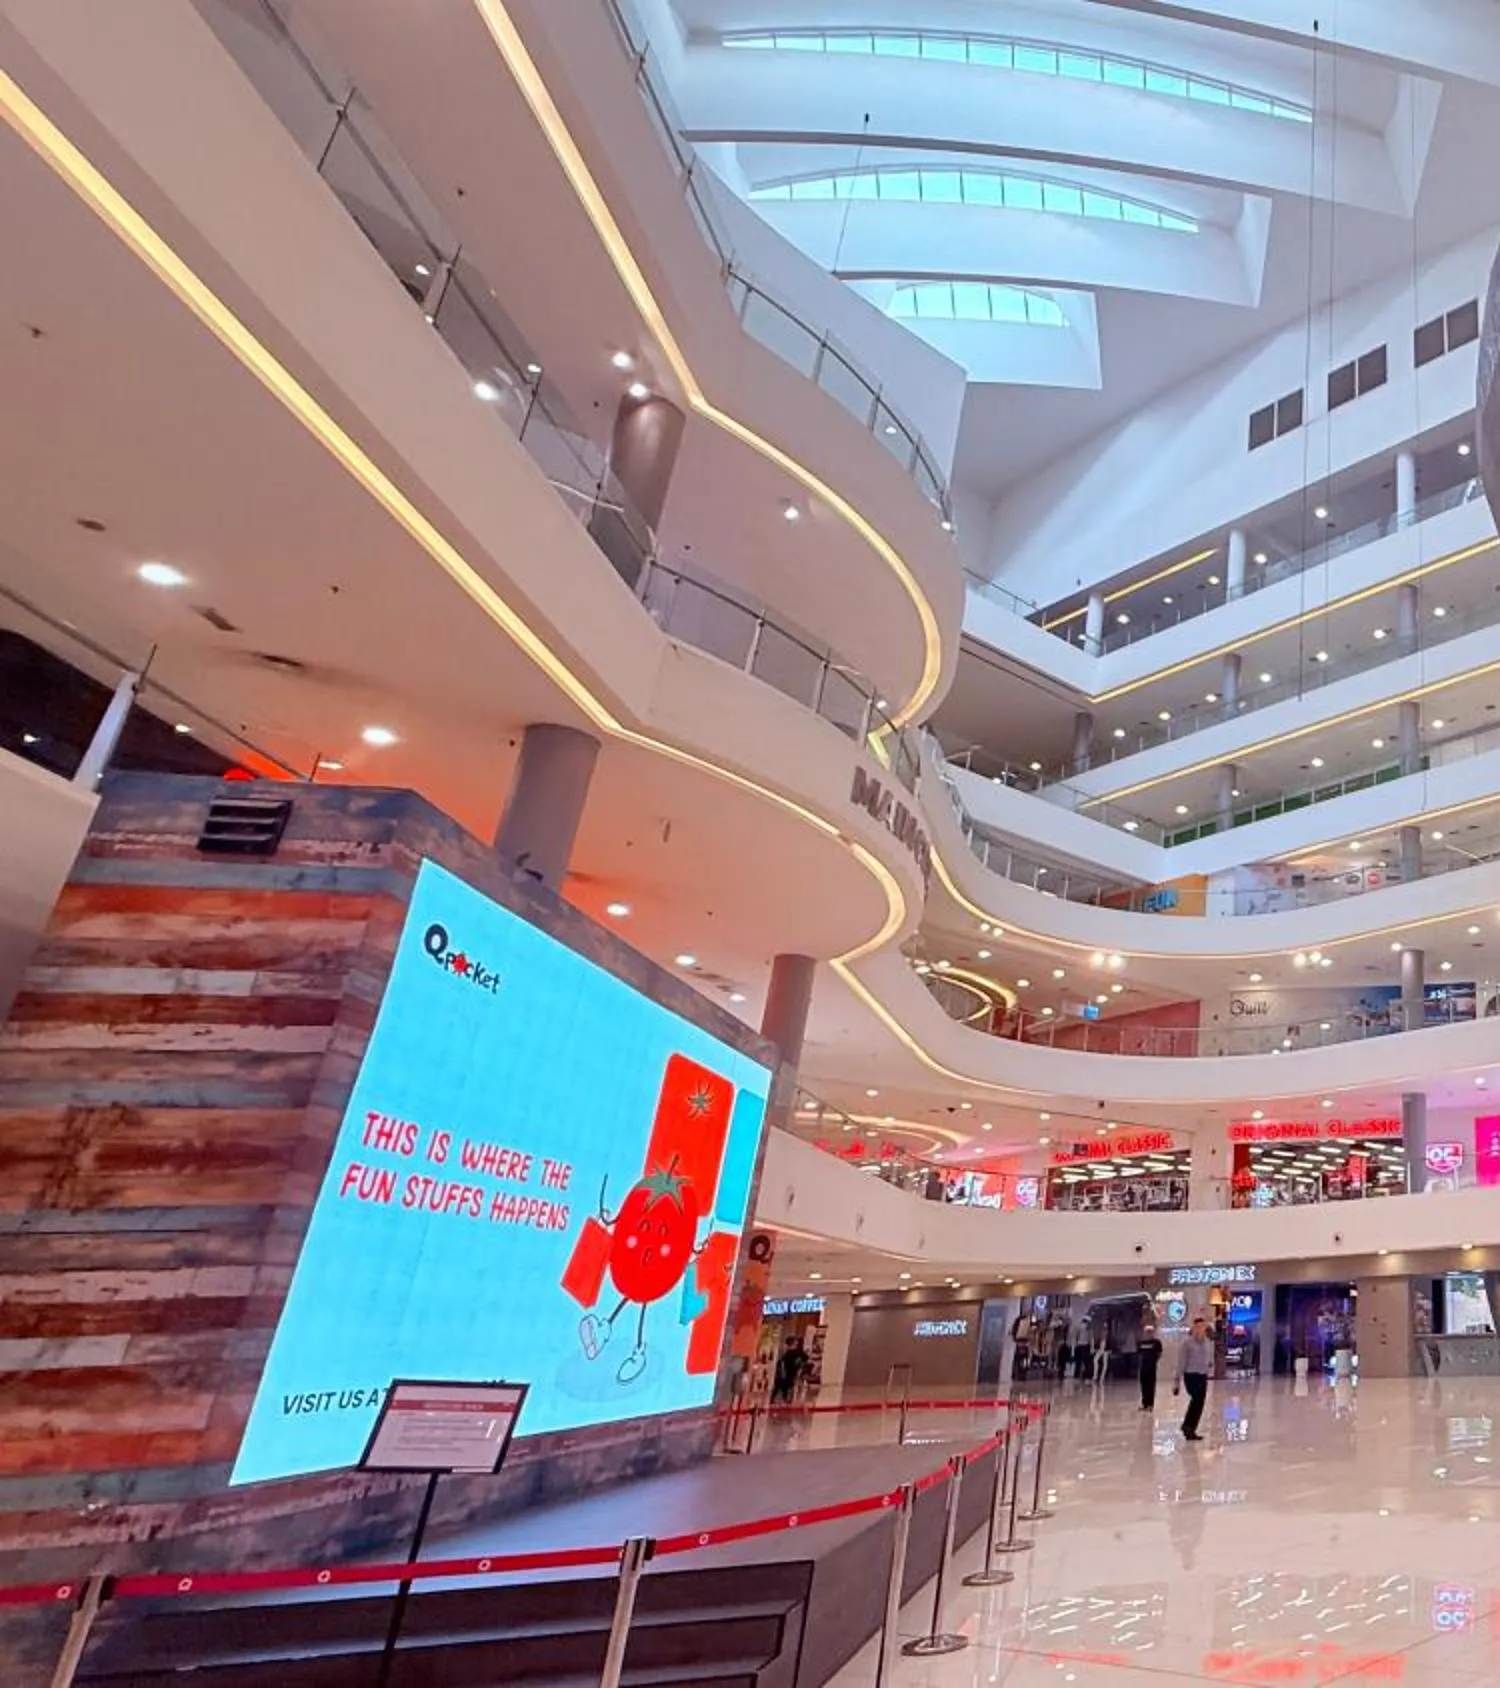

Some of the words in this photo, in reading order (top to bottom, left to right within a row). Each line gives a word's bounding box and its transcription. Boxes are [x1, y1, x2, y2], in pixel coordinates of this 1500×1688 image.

[363, 1112, 418, 1156] THIS
[427, 1129, 450, 1164] IS
[461, 1139, 533, 1182] WHERE
[541, 1159, 572, 1191] THE
[340, 1163, 397, 1204] FUN
[402, 1175, 484, 1217] STUFFS
[490, 1191, 570, 1231] HAPPENS
[283, 1392, 336, 1415] VISIT
[338, 1389, 365, 1409] US
[365, 1387, 389, 1407] A
